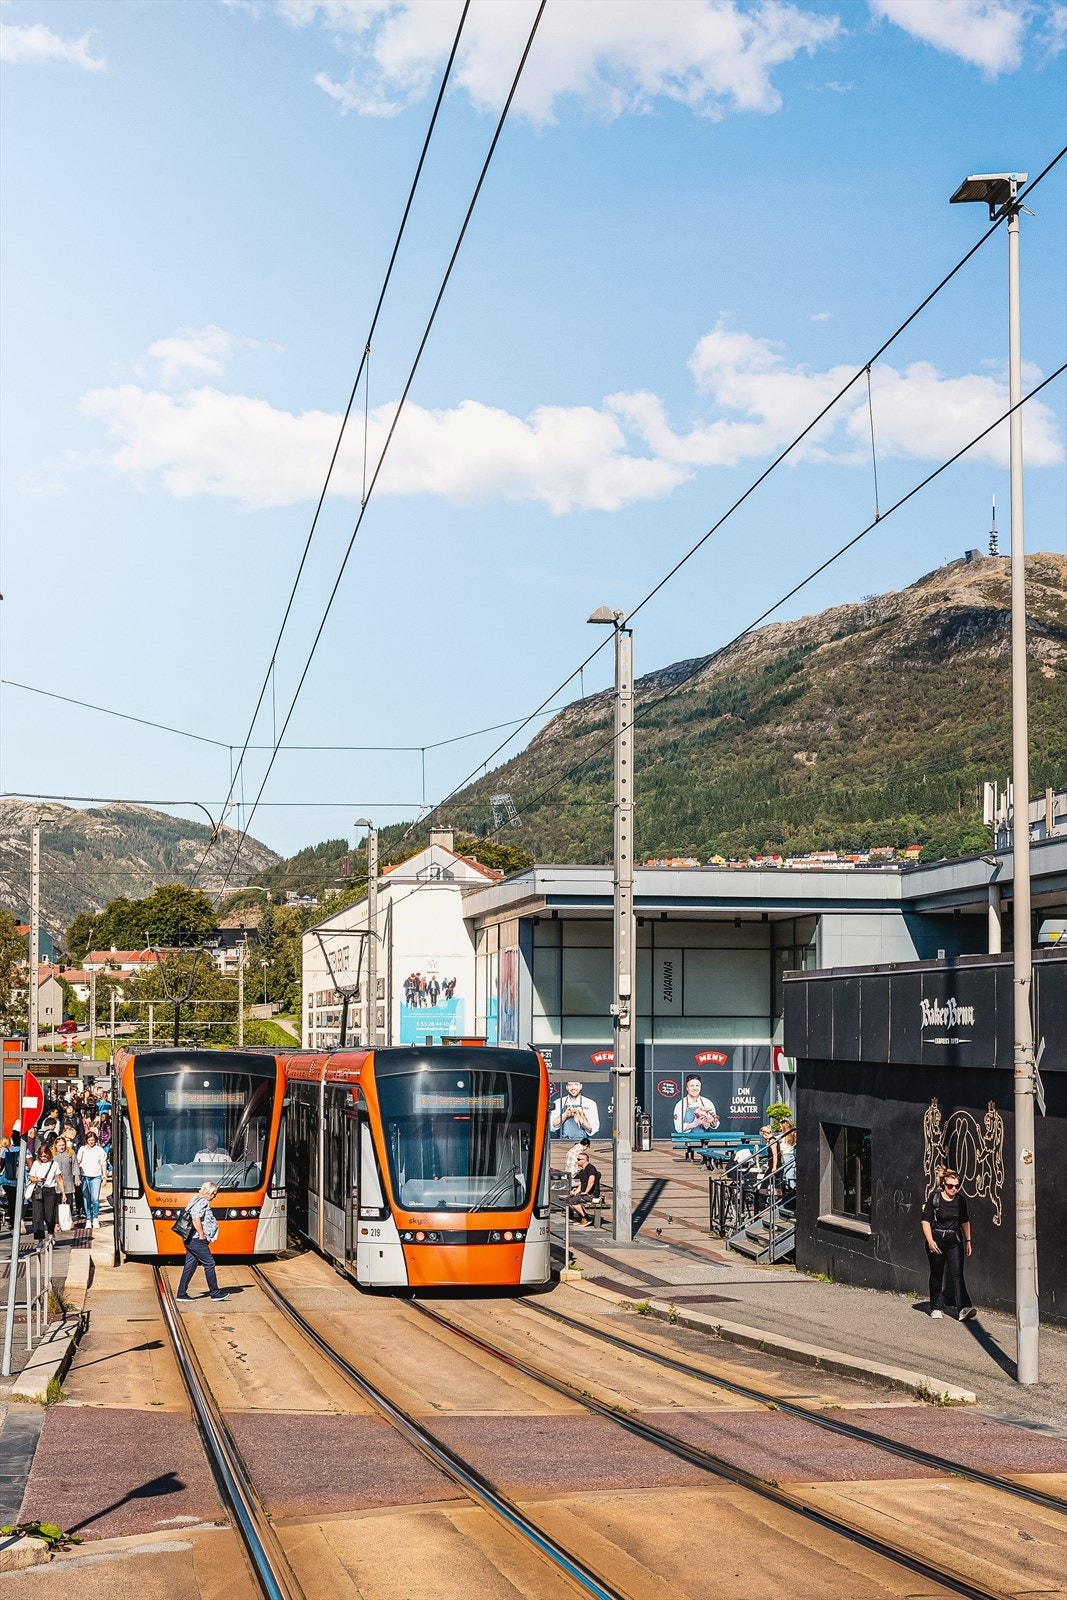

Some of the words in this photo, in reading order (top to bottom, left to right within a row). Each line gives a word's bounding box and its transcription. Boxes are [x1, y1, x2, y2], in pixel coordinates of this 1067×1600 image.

[663, 961, 673, 1003] ZAVANNA
[594, 1053, 614, 1062] MEN
[699, 1053, 725, 1063] MENY
[370, 1228, 381, 1237] 219
